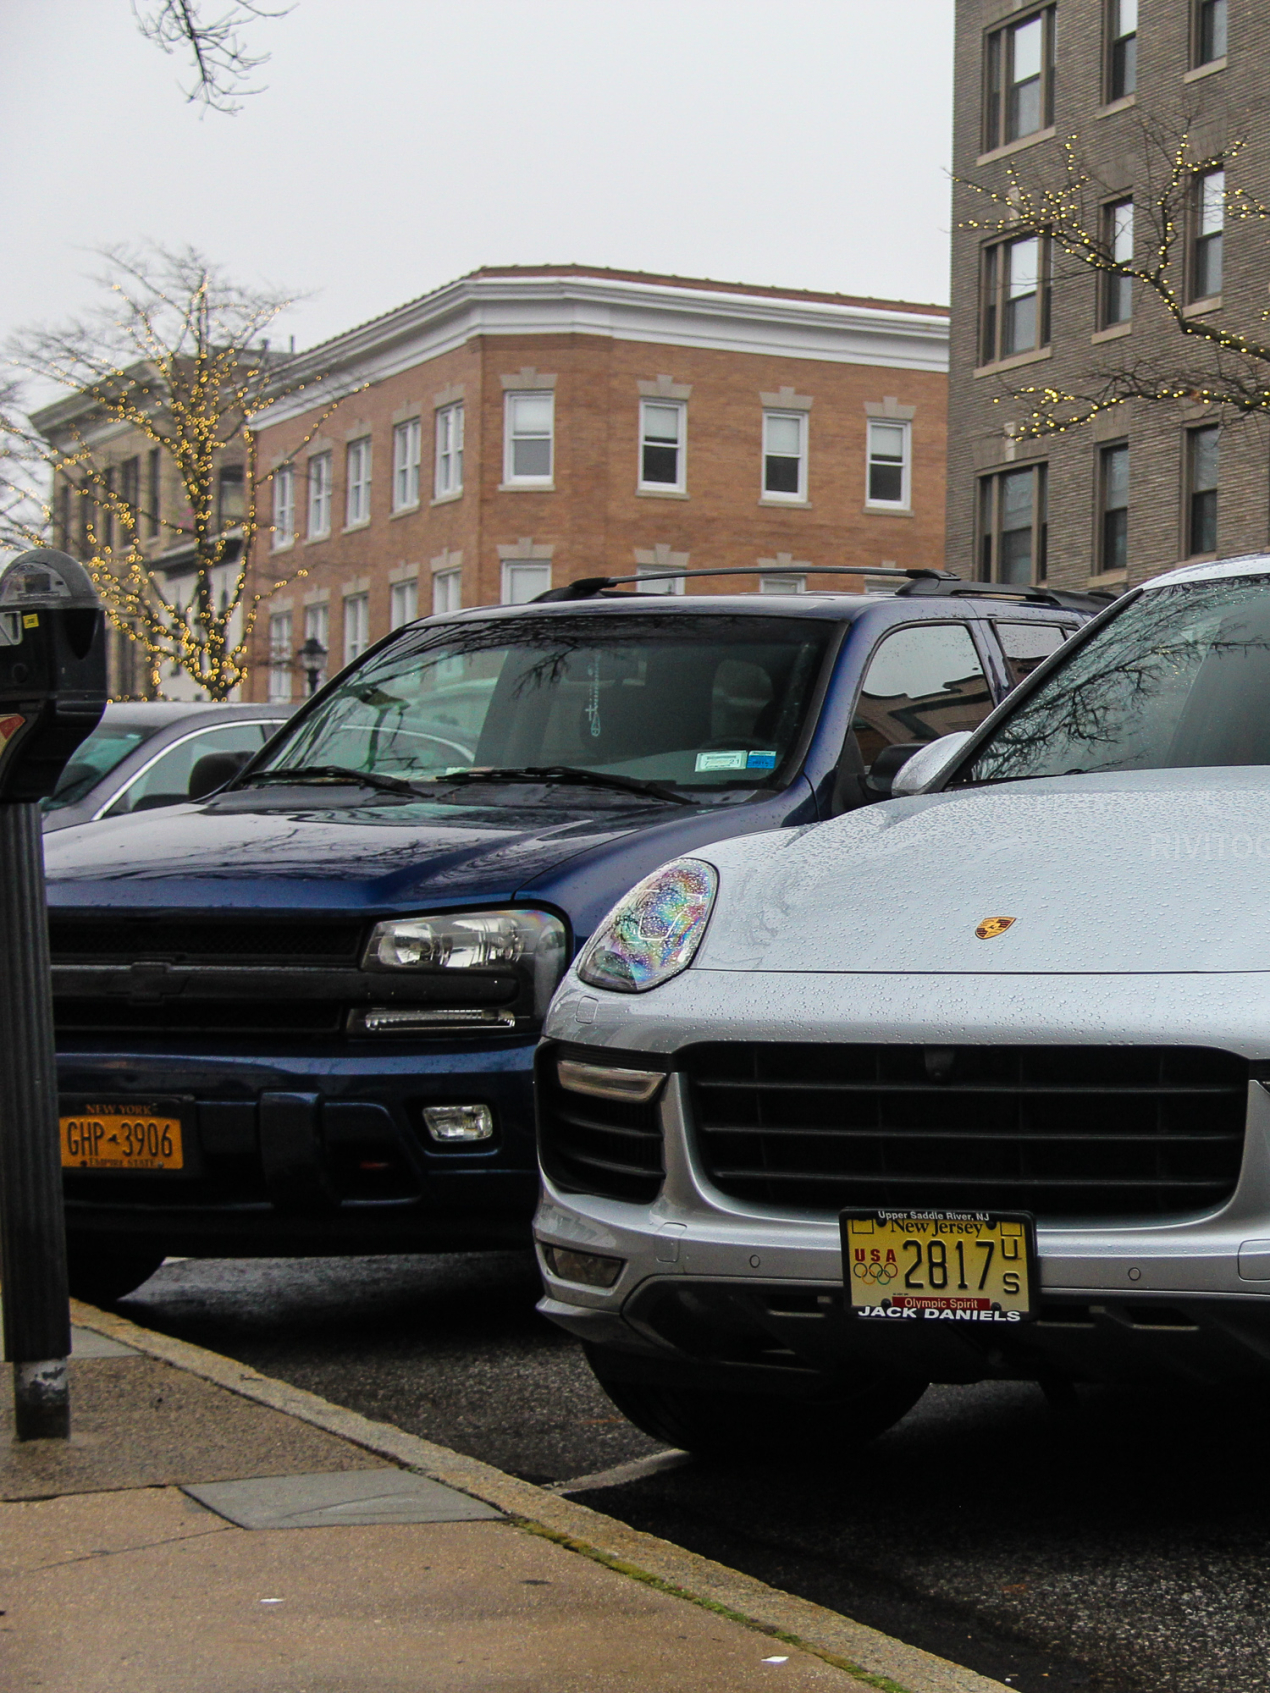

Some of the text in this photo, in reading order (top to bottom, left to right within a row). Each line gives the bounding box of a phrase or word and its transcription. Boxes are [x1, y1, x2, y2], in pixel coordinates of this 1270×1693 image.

[86, 1104, 152, 1115] NEW YORK
[127, 1159, 155, 1168] STATE
[878, 1211, 990, 1221] Upper Saddle River, NJ
[890, 1219, 984, 1238] New Jersey
[854, 1248, 897, 1262] USA
[902, 1239, 995, 1291] 2817
[904, 1297, 978, 1309] Olympic Spirit
[858, 1306, 1021, 1322] JACK DANIELS
